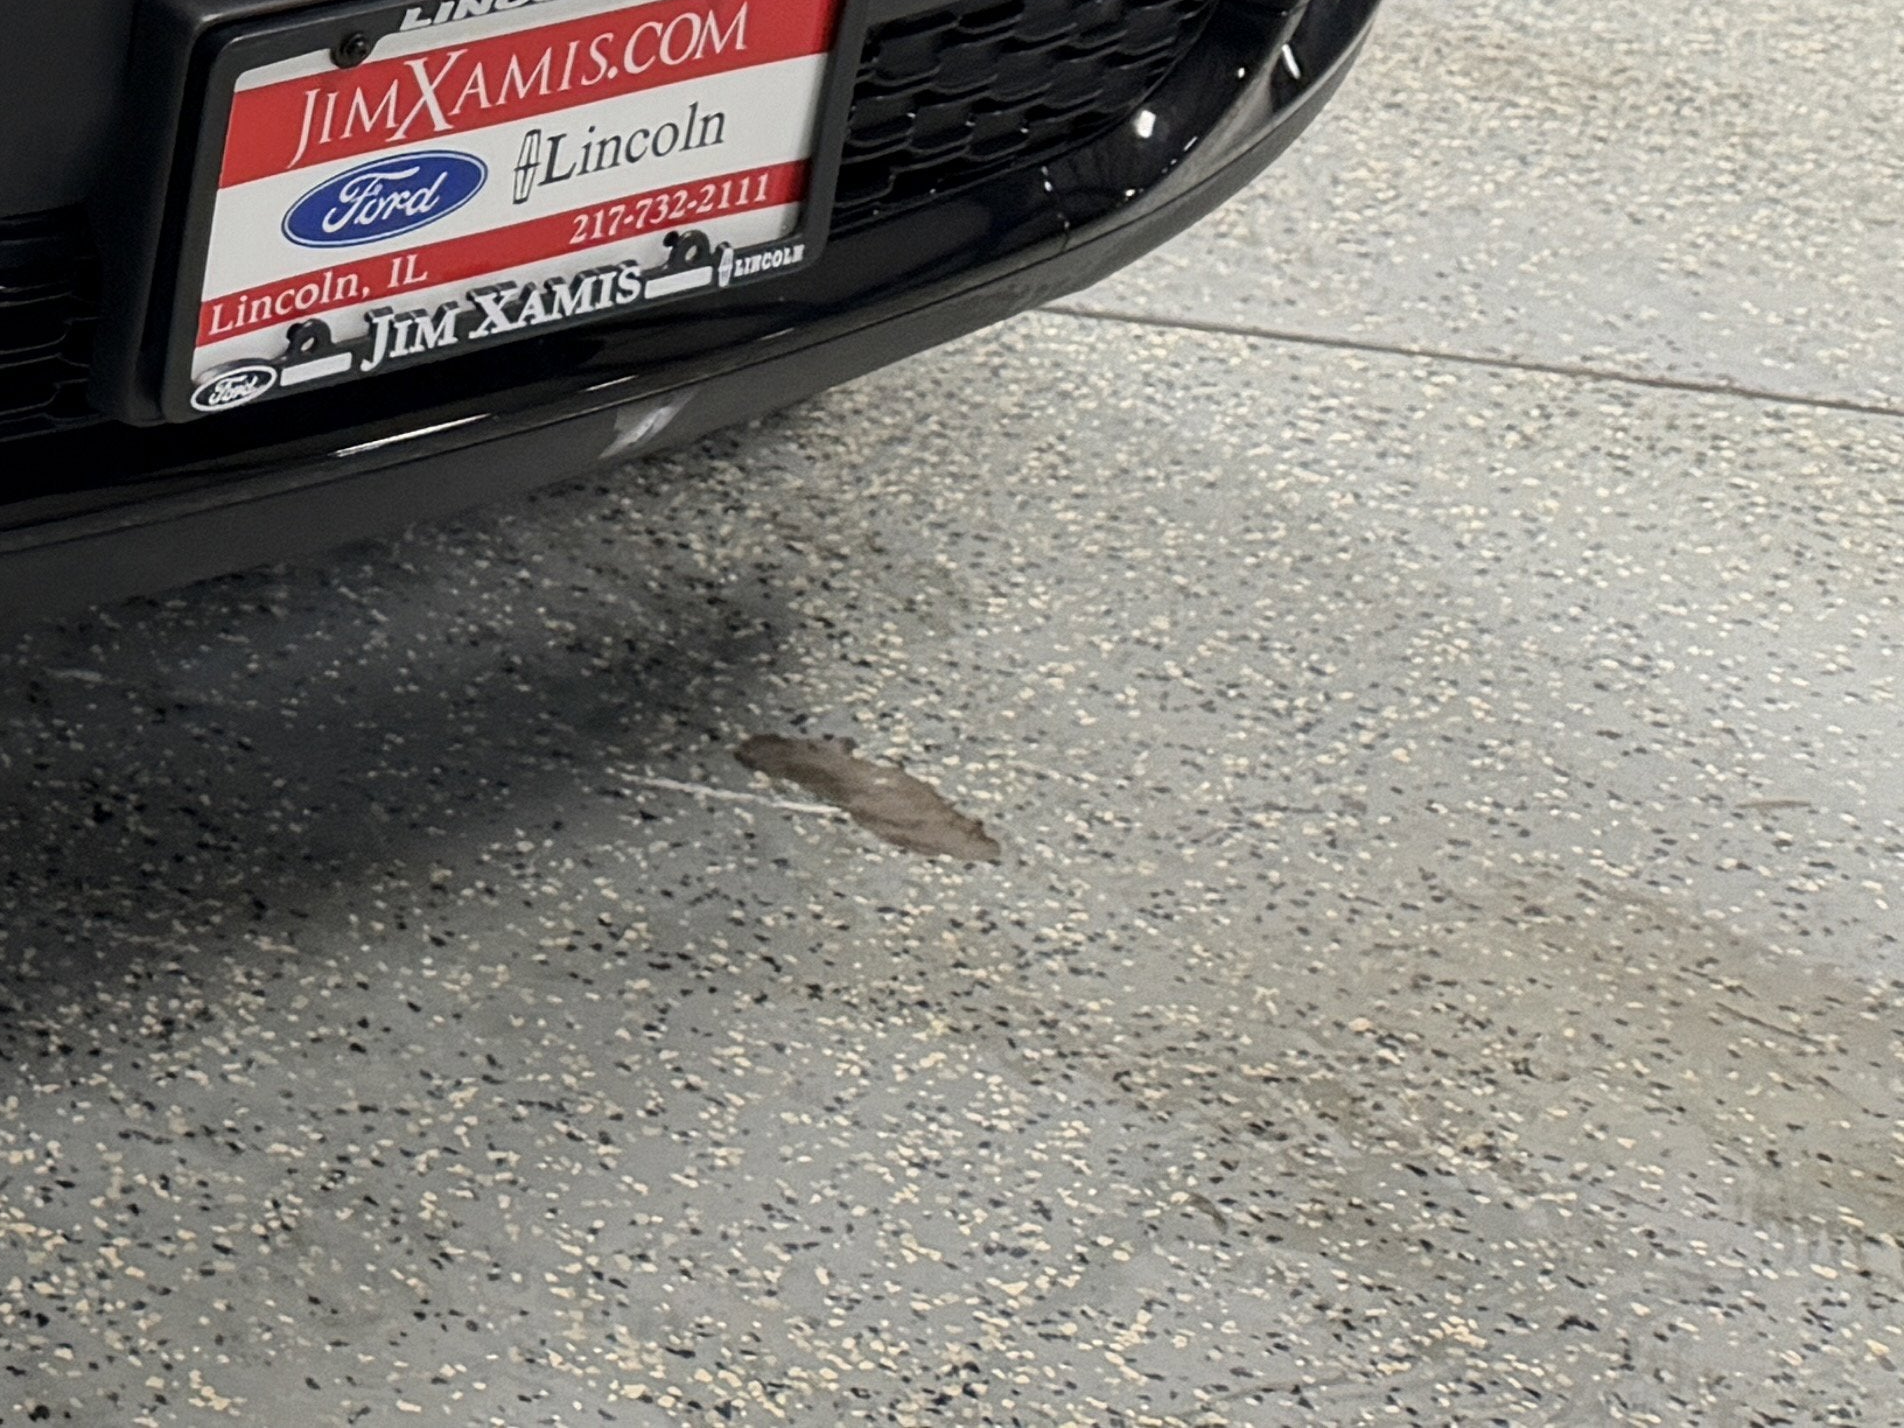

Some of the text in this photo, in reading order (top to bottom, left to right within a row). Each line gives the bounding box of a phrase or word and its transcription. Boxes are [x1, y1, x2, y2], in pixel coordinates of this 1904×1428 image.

[286, 1, 749, 170] JIMXAMIS.COM
[538, 101, 727, 187] Lincoln
[322, 165, 440, 234] Ford
[569, 173, 770, 245] 217-732-2111
[208, 253, 429, 337] Lincoln, IL
[733, 243, 806, 278] LINCOLN
[360, 264, 643, 373] JIM XAMIS
